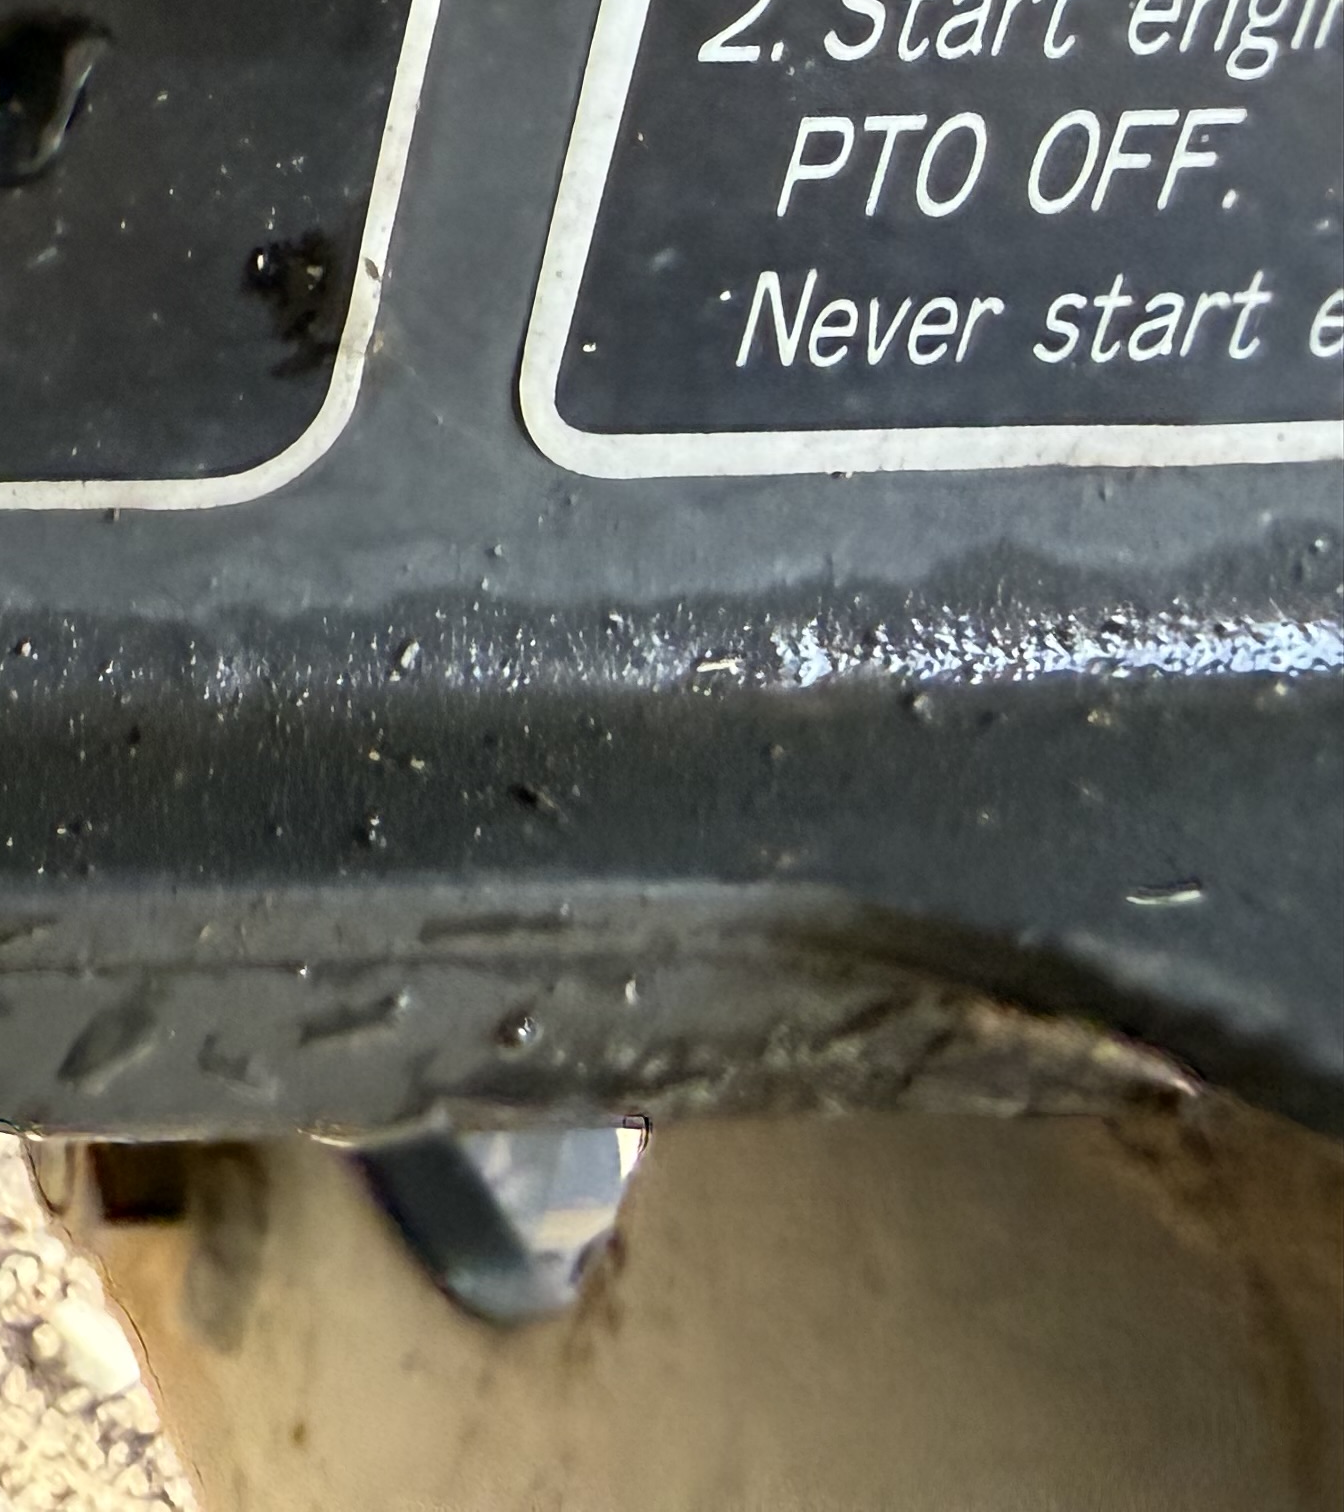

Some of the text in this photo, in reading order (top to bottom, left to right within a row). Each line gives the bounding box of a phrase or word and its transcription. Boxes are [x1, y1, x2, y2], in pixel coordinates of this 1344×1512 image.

[776, 107, 1248, 218] PTO OFF.
[736, 268, 1005, 368] Never
[1032, 270, 1273, 364] start
